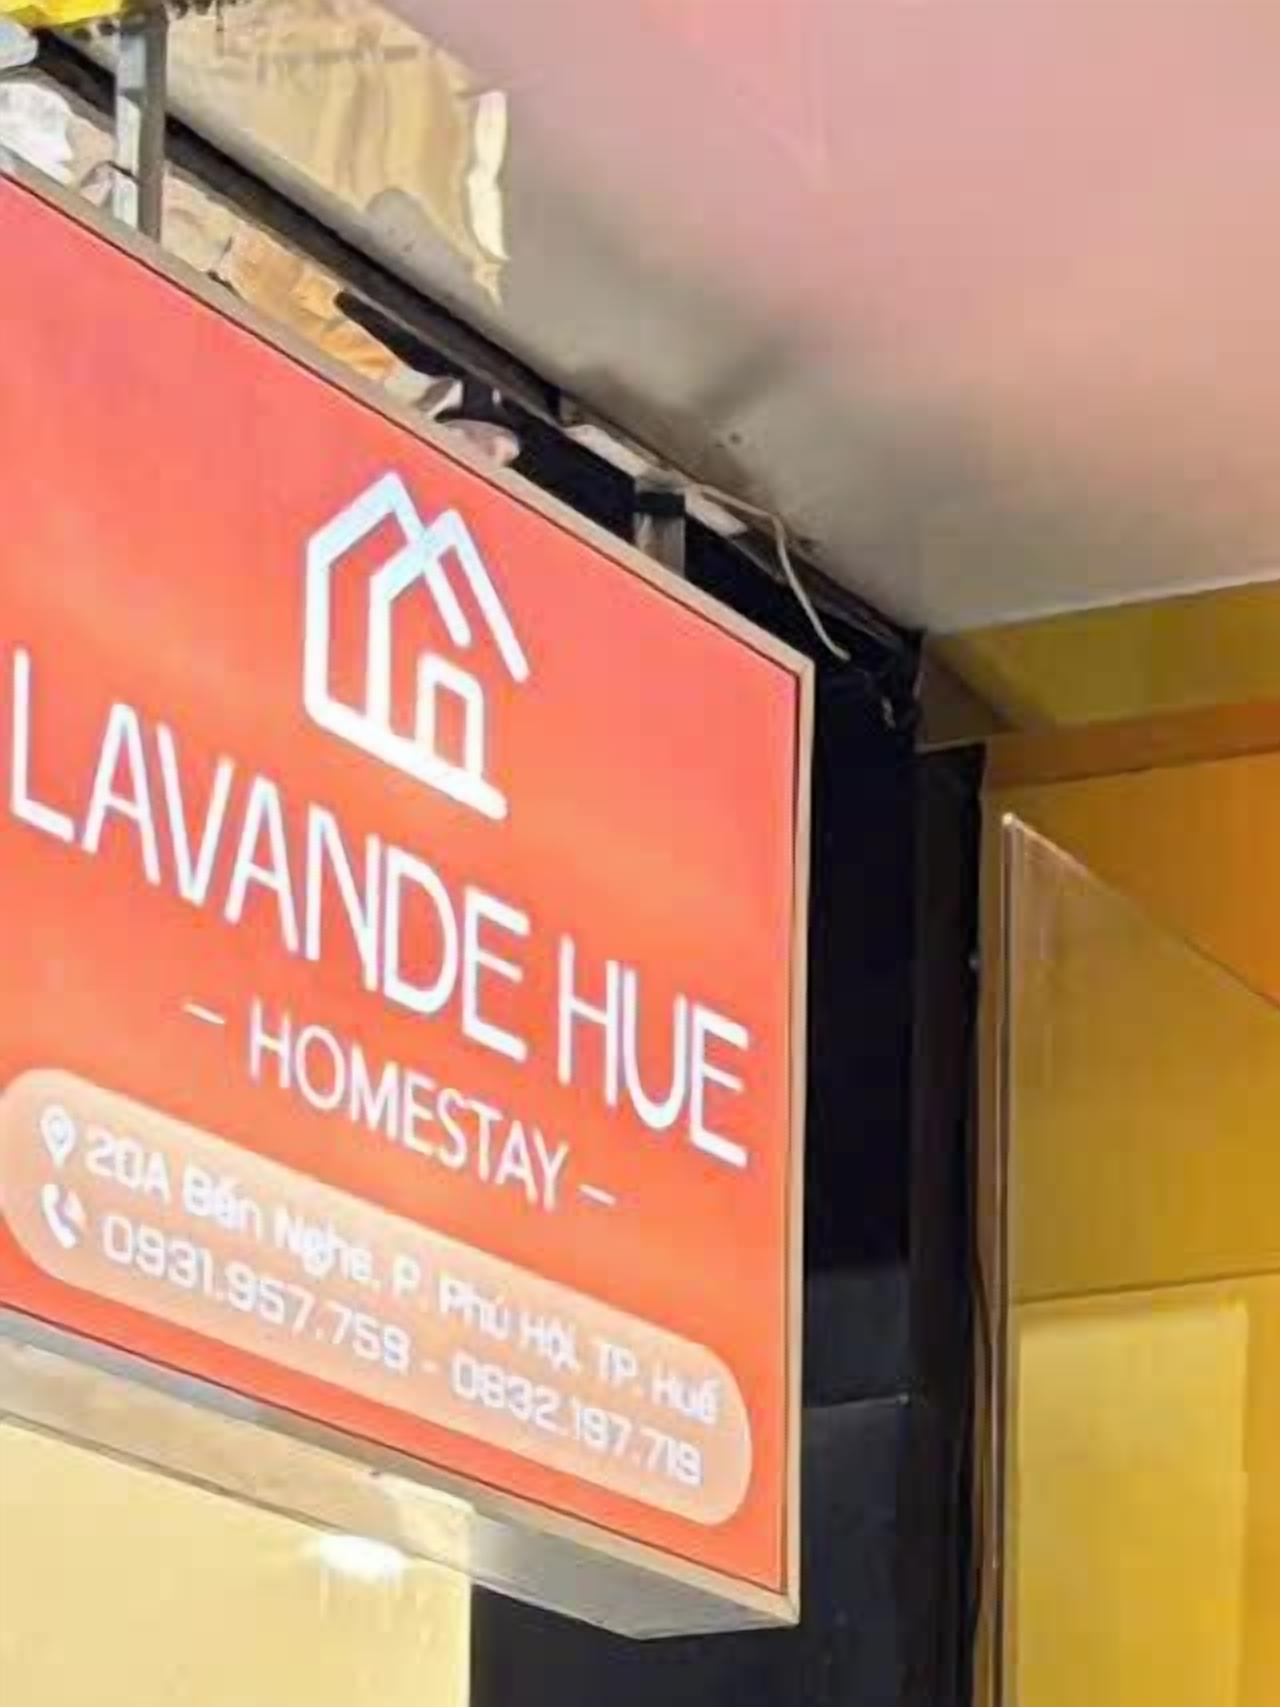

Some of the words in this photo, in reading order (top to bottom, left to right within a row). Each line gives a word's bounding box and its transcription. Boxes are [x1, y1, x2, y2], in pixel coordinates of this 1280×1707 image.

[12, 647, 531, 1063] LAVANDE
[558, 935, 750, 1168] HUE
[84, 1125, 172, 1205] 20A
[248, 998, 571, 1213] HOMESTAY
